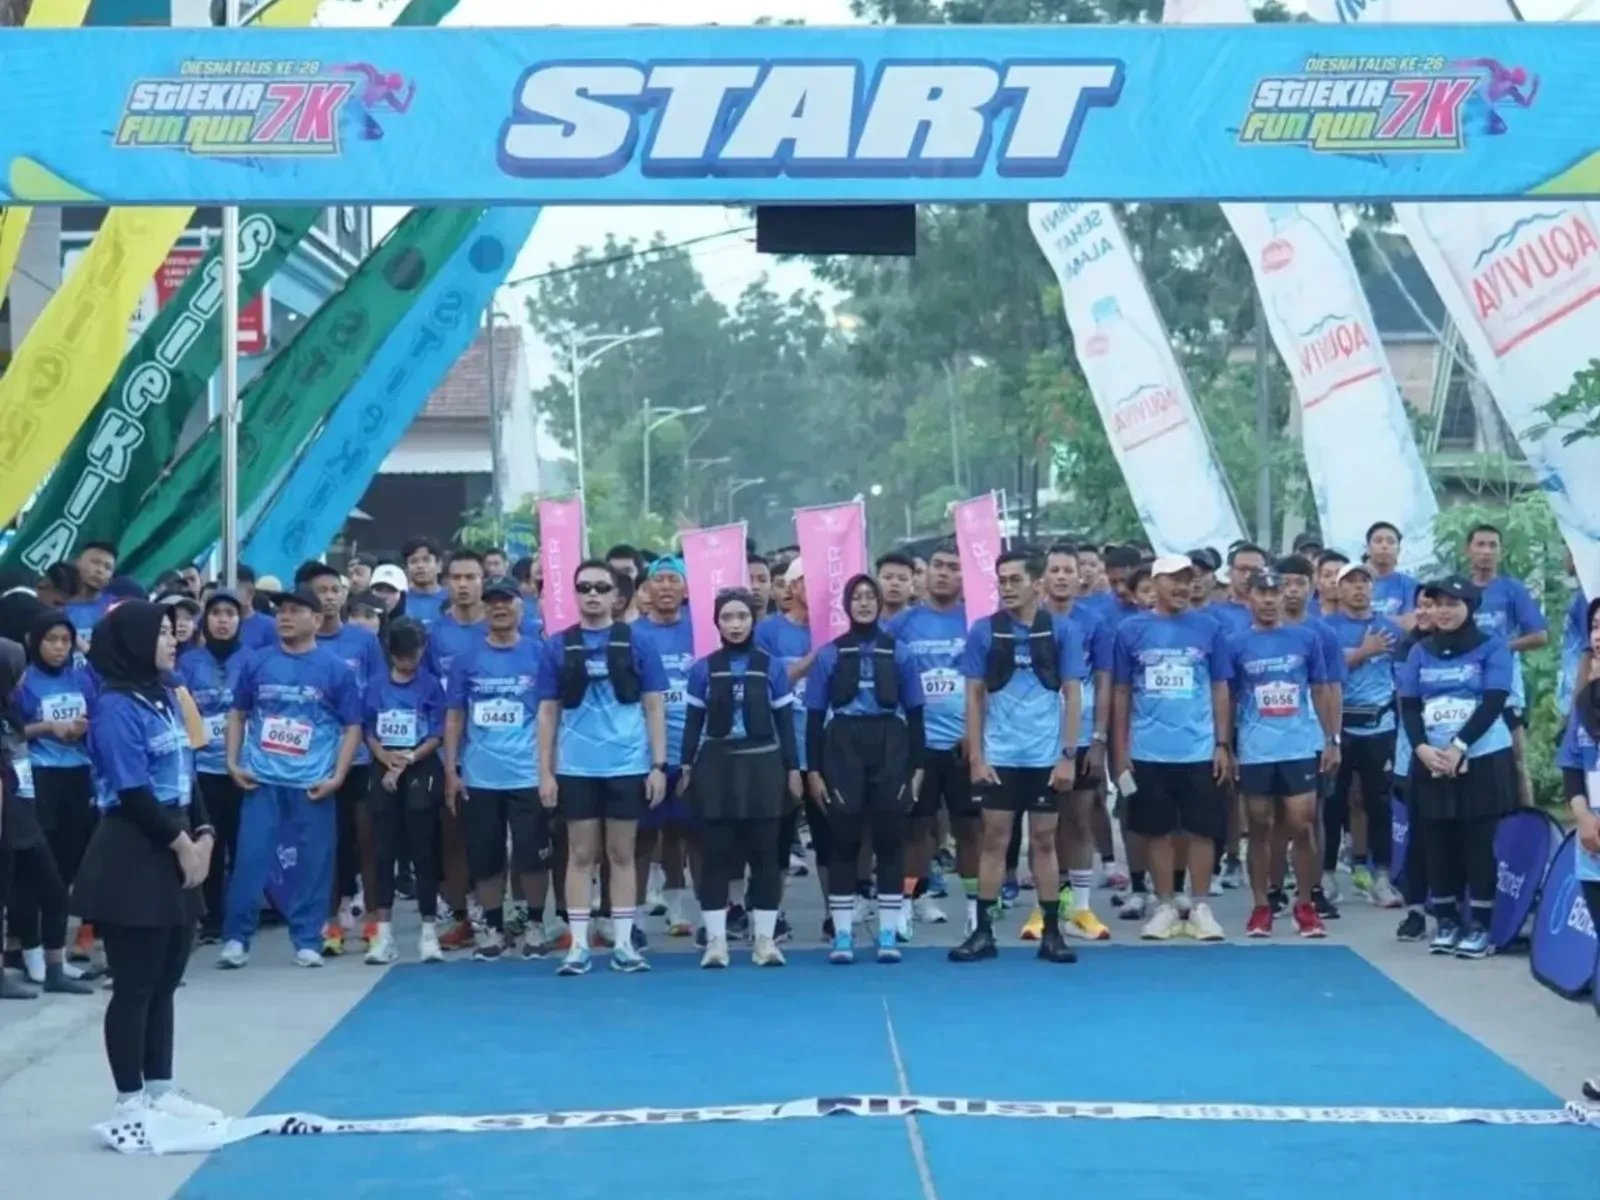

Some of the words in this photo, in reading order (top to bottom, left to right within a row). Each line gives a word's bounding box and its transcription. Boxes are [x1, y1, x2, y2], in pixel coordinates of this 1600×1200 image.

[1305, 56, 1396, 72] DIESNATALIS
[501, 62, 1122, 172] START
[1375, 78, 1477, 139] 7K
[827, 546, 848, 627] PACER
[268, 729, 303, 746] 0696
[482, 712, 516, 724] 0443
